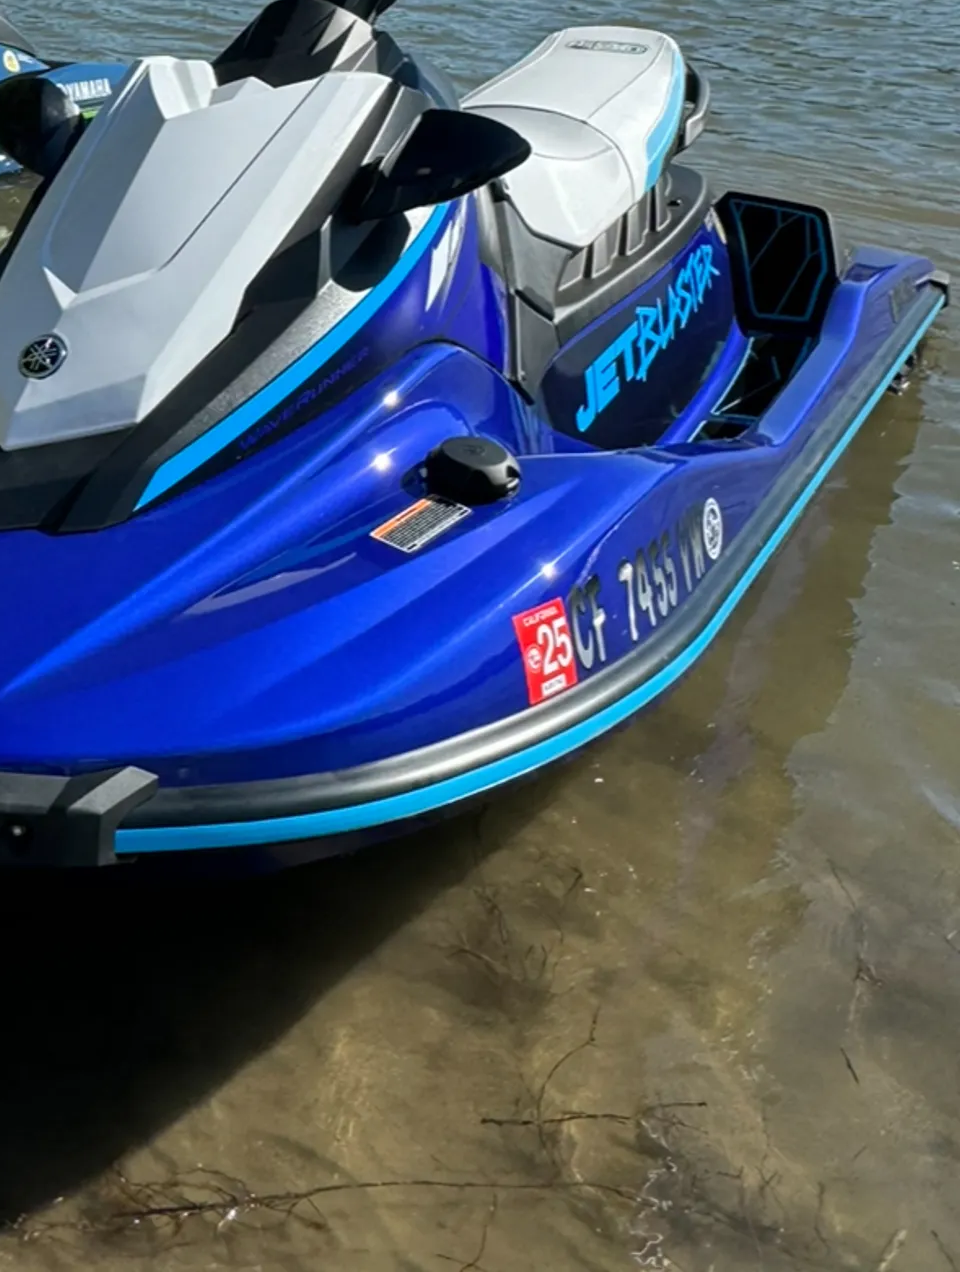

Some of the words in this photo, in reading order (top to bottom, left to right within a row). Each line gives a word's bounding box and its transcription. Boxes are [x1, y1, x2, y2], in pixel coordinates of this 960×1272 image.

[536, 616, 573, 676] 25
[567, 573, 607, 669] CF
[617, 529, 678, 642] 7455
